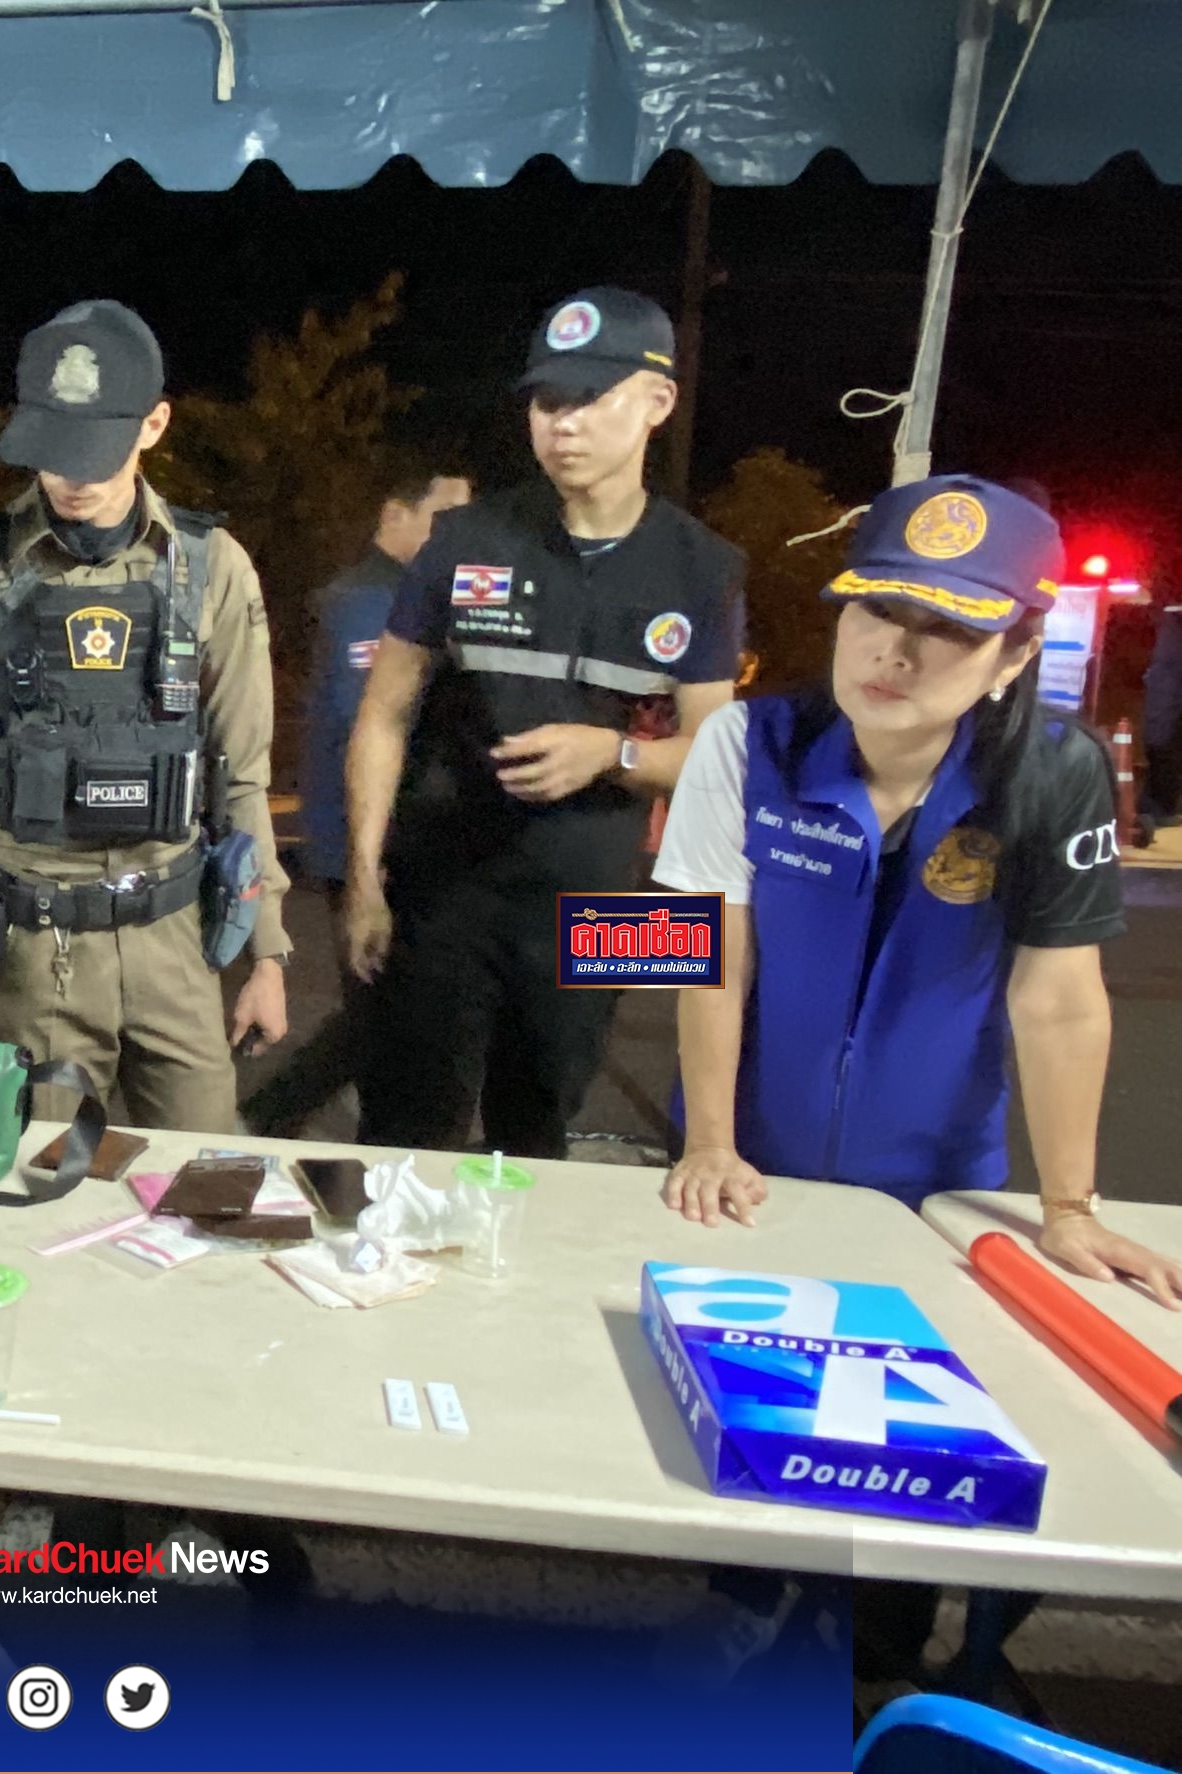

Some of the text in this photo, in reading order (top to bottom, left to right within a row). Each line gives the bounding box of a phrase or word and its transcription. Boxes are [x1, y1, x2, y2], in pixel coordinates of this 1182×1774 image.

[91, 786, 145, 801] POLICE
[723, 1330, 912, 1361] Double A
[780, 1454, 977, 1504] Double A
